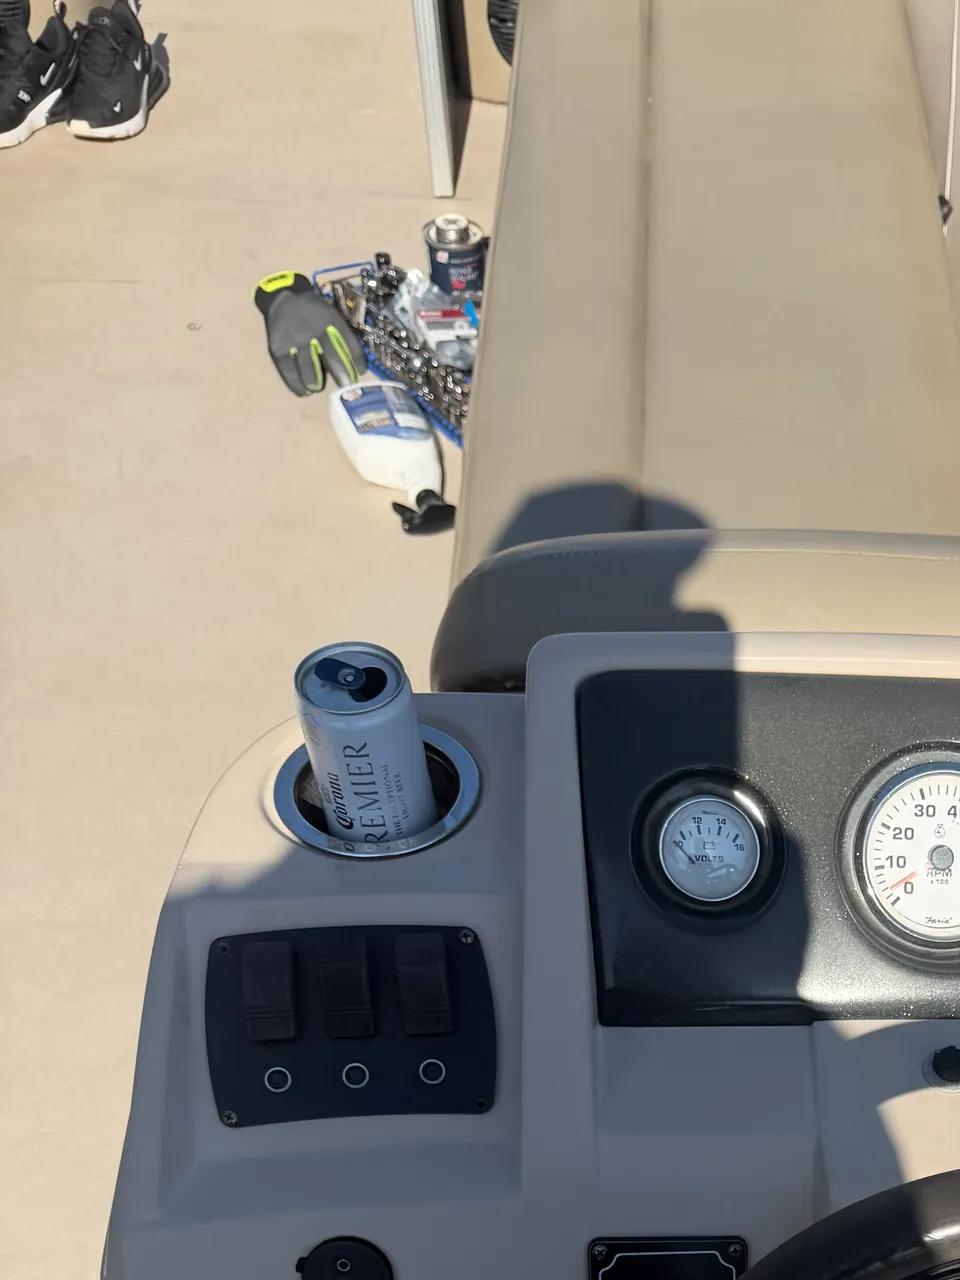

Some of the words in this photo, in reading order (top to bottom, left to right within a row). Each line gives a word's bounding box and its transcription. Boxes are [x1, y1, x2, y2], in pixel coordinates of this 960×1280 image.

[342, 742, 388, 844] REMIER
[381, 764, 400, 819] EEPTIONAL
[327, 771, 355, 830] Corona
[914, 804, 936, 818] 30
[692, 816, 702, 824] 12
[892, 827, 914, 840] 20
[734, 843, 745, 852] 16
[694, 854, 724, 863] VOLTS
[885, 855, 906, 869] 10
[926, 867, 953, 878] RPM
[904, 881, 914, 895] 0
